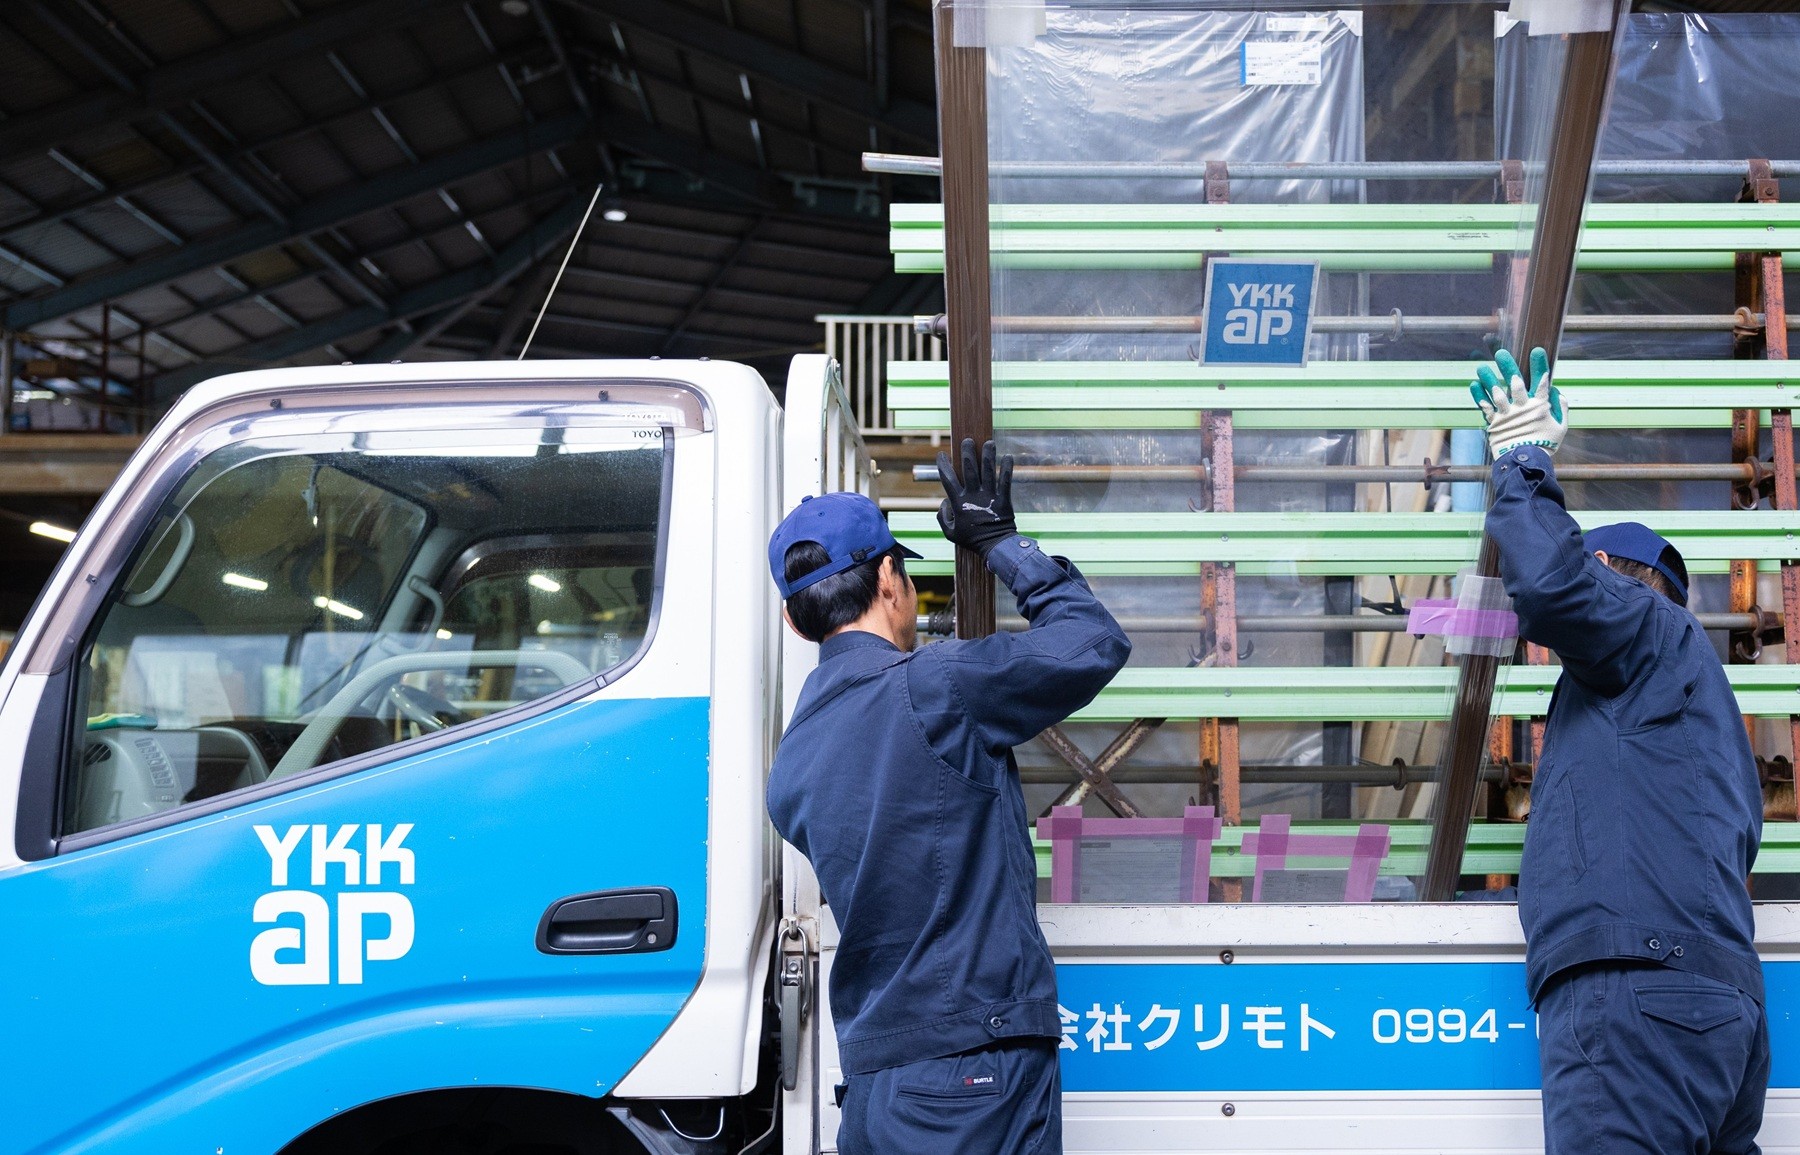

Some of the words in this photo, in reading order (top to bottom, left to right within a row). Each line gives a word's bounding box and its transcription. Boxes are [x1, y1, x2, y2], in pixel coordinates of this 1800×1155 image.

[1227, 283, 1296, 307] YKK
[252, 823, 415, 886] YKK
[249, 889, 415, 986] ap
[1371, 1007, 1540, 1045] 0994-
